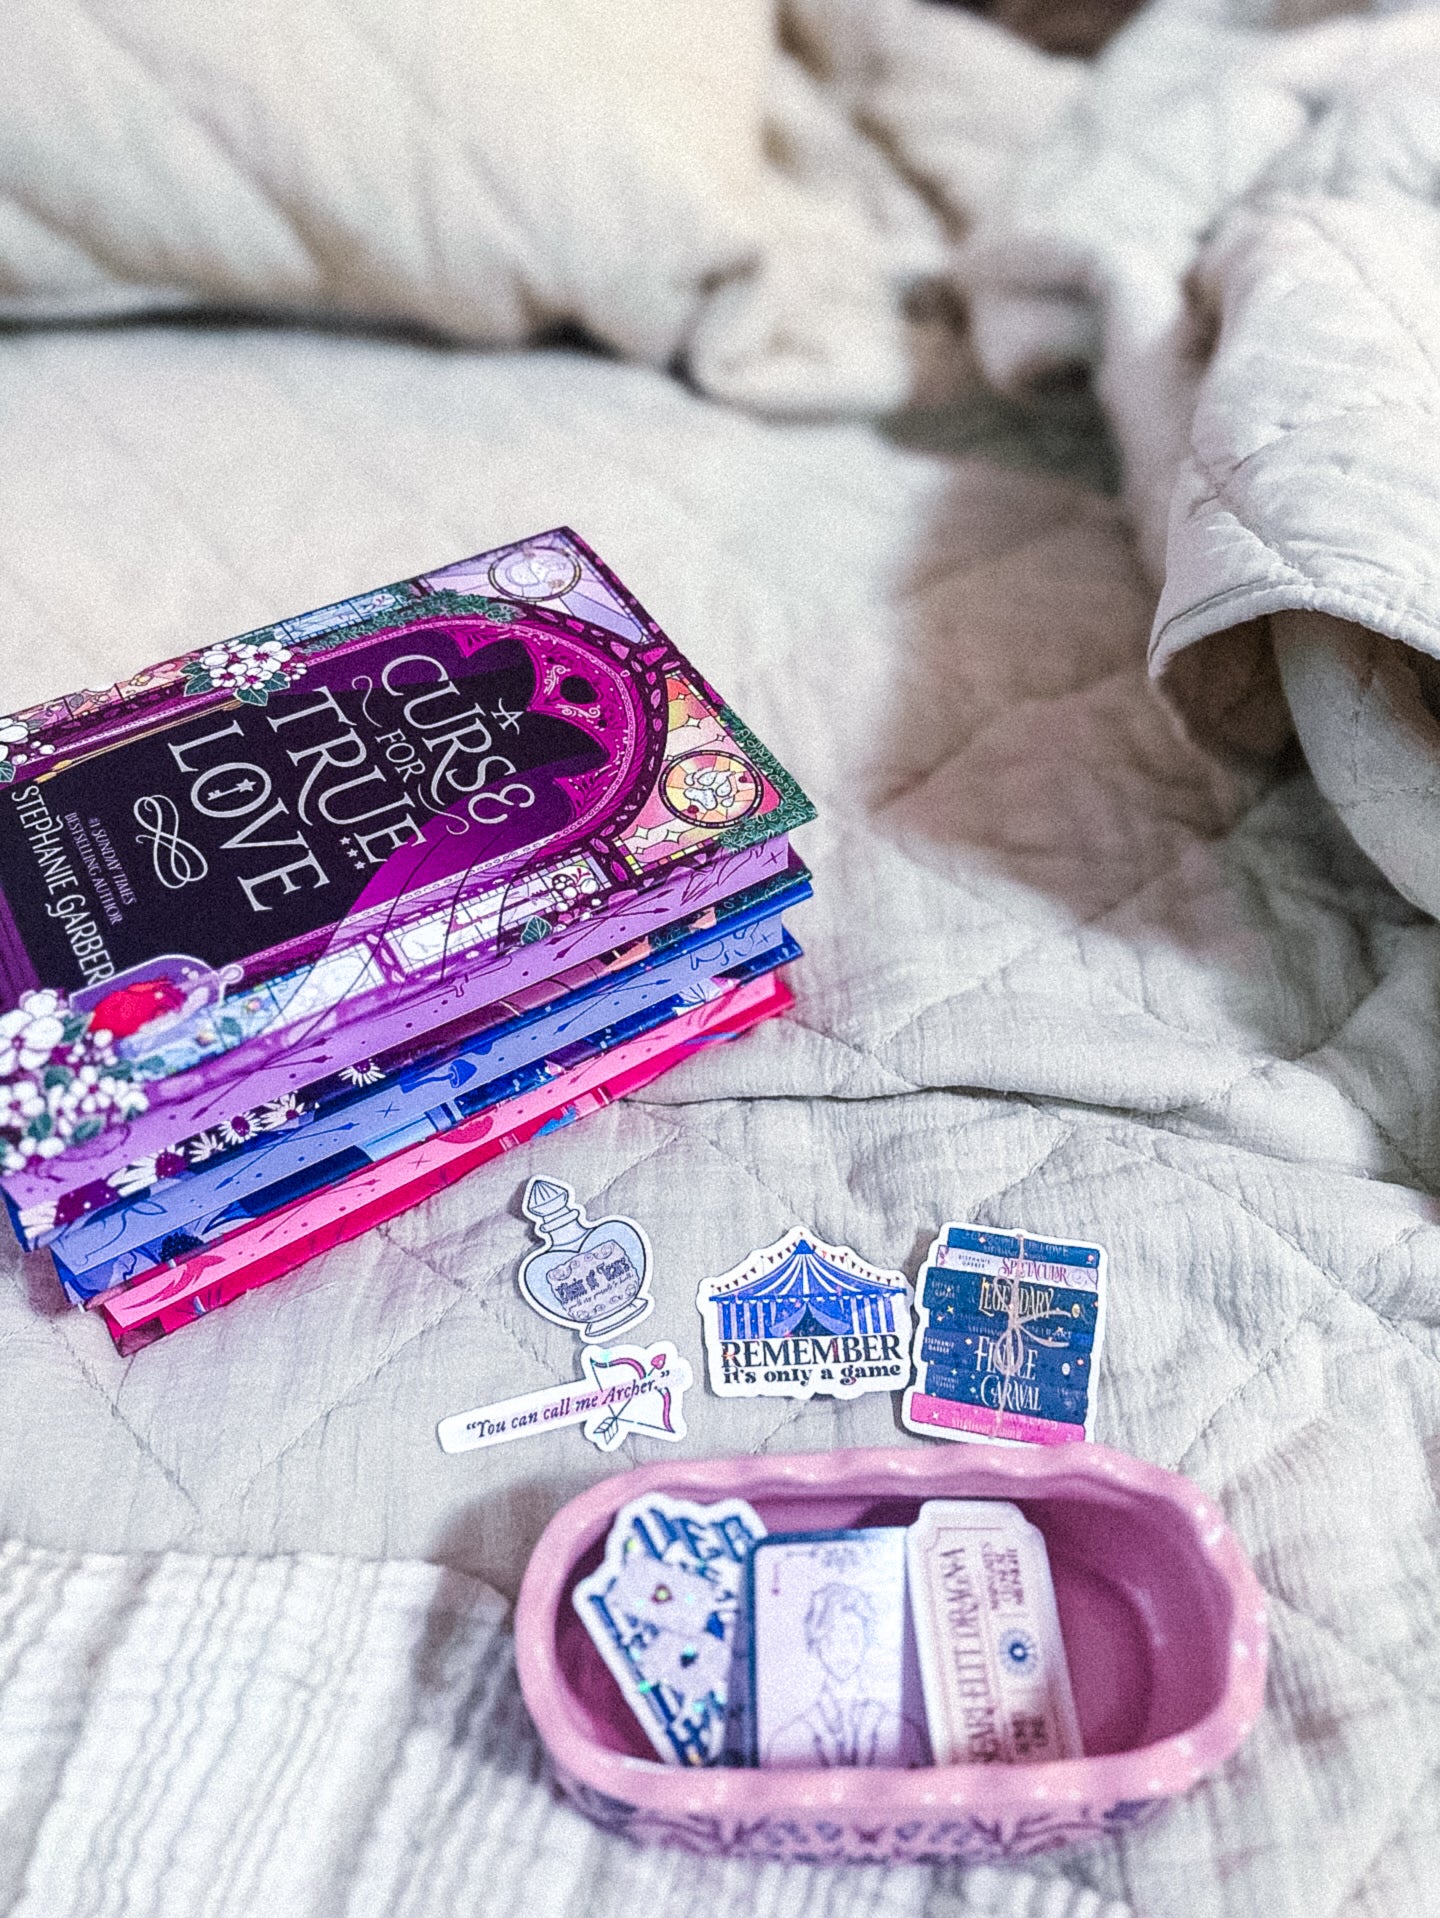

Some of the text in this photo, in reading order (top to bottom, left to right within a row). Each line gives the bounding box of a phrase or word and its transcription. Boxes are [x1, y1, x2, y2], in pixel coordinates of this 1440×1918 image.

[381, 653, 536, 825] CURSE
[490, 697, 524, 735] A
[266, 686, 428, 864] TRUE
[375, 728, 427, 783] FOR
[167, 720, 331, 912] LOVE
[11, 785, 116, 986] STEPHANIE GARBER
[64, 812, 124, 926] BESTSELLING AUTHOR
[91, 827, 124, 872] SUNDAY
[113, 870, 138, 906] TIMES
[999, 1259, 1070, 1286] SPCTACULAR
[979, 1277, 1054, 1318] LEGEDARY
[720, 1334, 904, 1369] REMEMBER
[723, 1364, 902, 1386] it's only a game
[466, 1418, 507, 1438] “You
[511, 1411, 539, 1429] can
[543, 1397, 571, 1421] call
[575, 1394, 599, 1412] me
[980, 1374, 1042, 1411] CARAVAL
